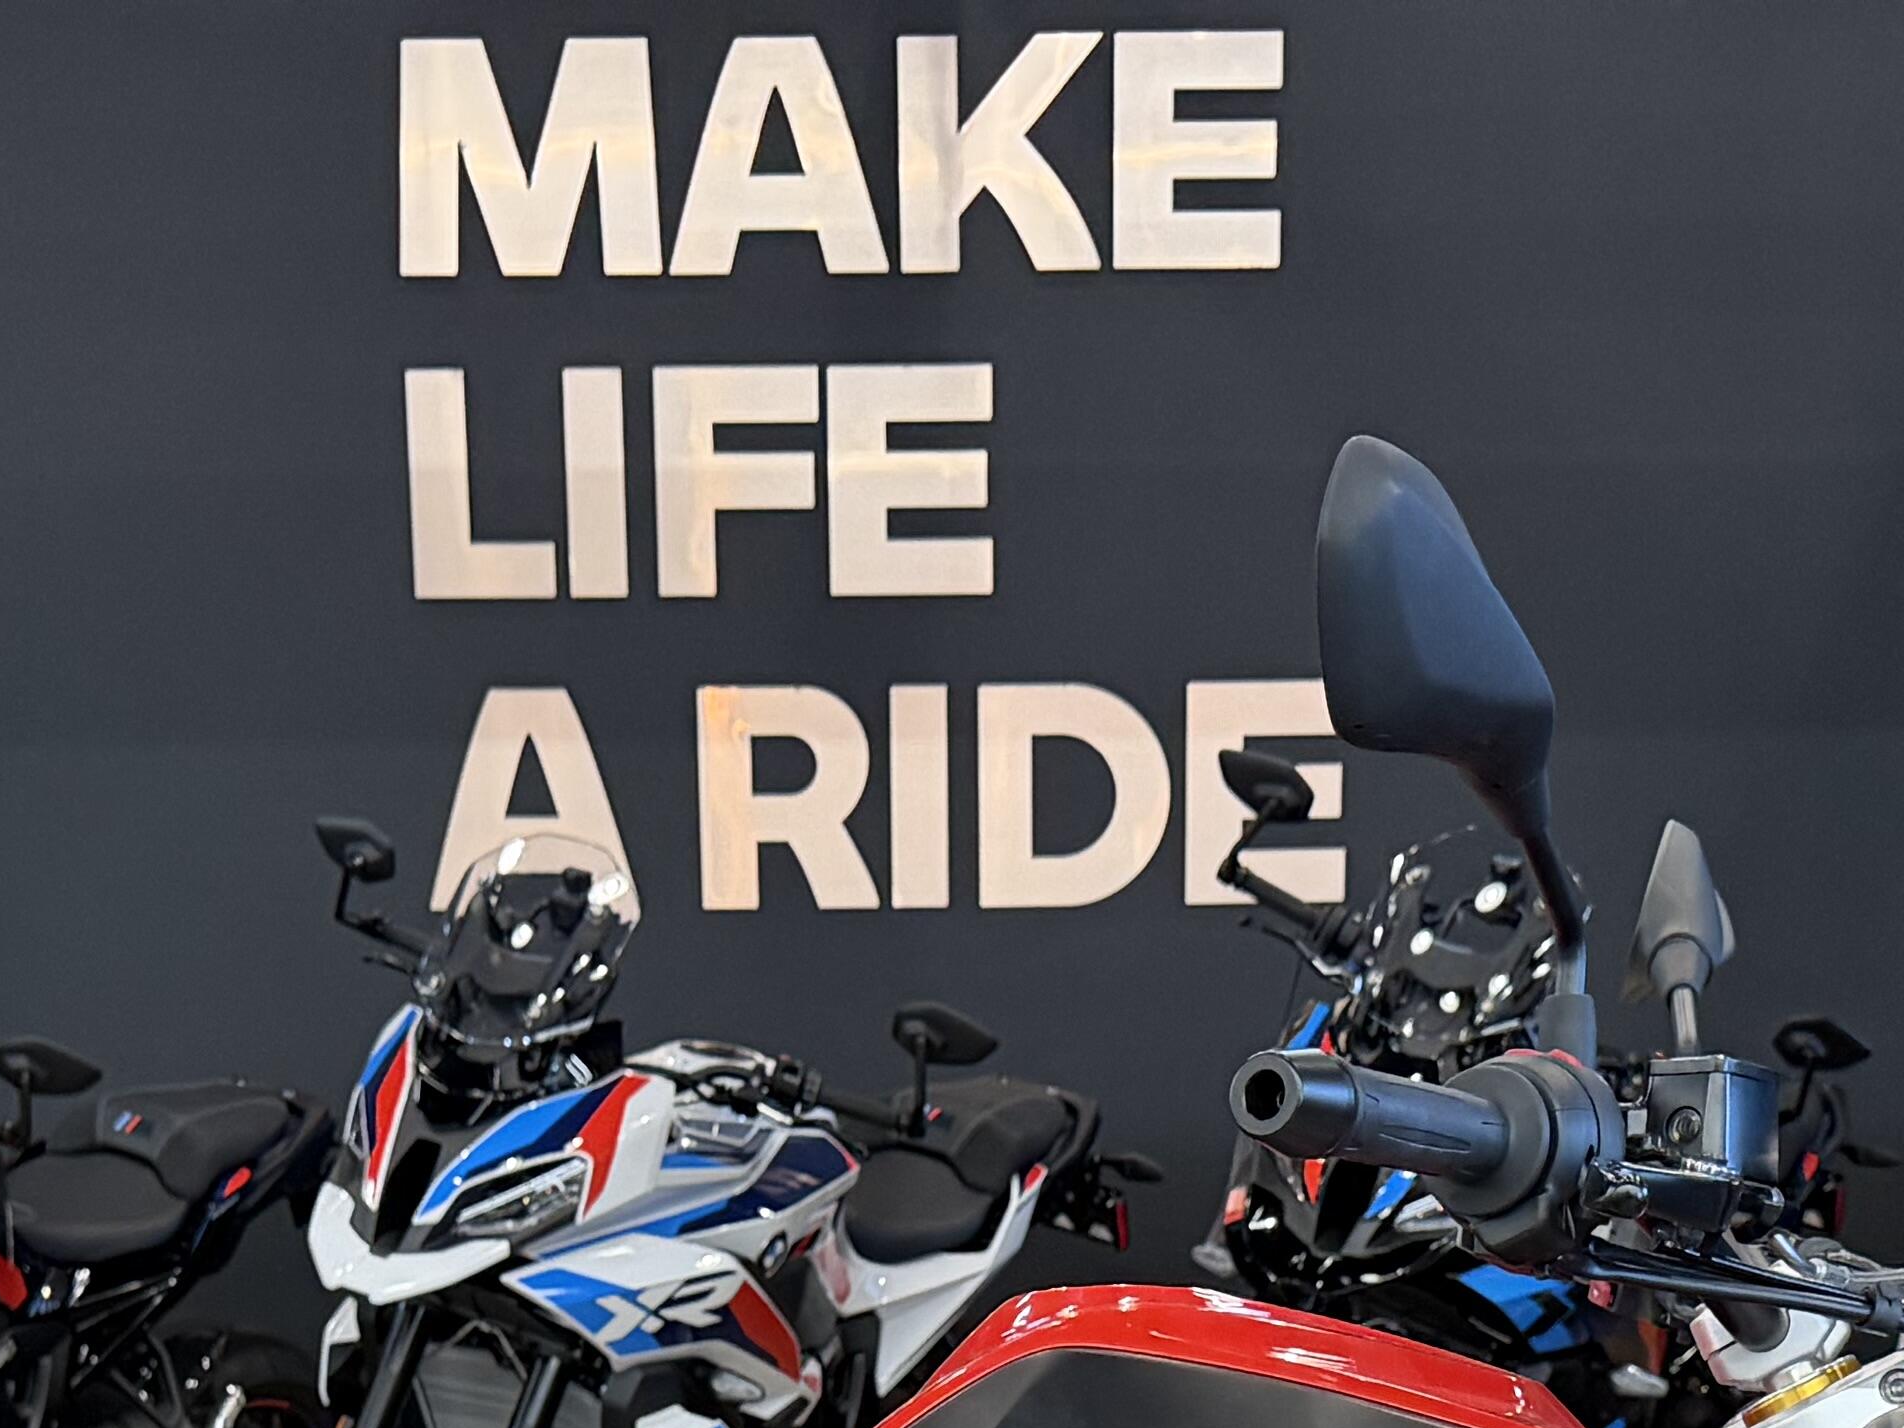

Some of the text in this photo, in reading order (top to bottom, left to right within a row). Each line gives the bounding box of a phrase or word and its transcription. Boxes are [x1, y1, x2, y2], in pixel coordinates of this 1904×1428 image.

[399, 30, 1285, 277] MAKE
[403, 362, 994, 599] LIFE
[429, 677, 1347, 921] A RIDE
